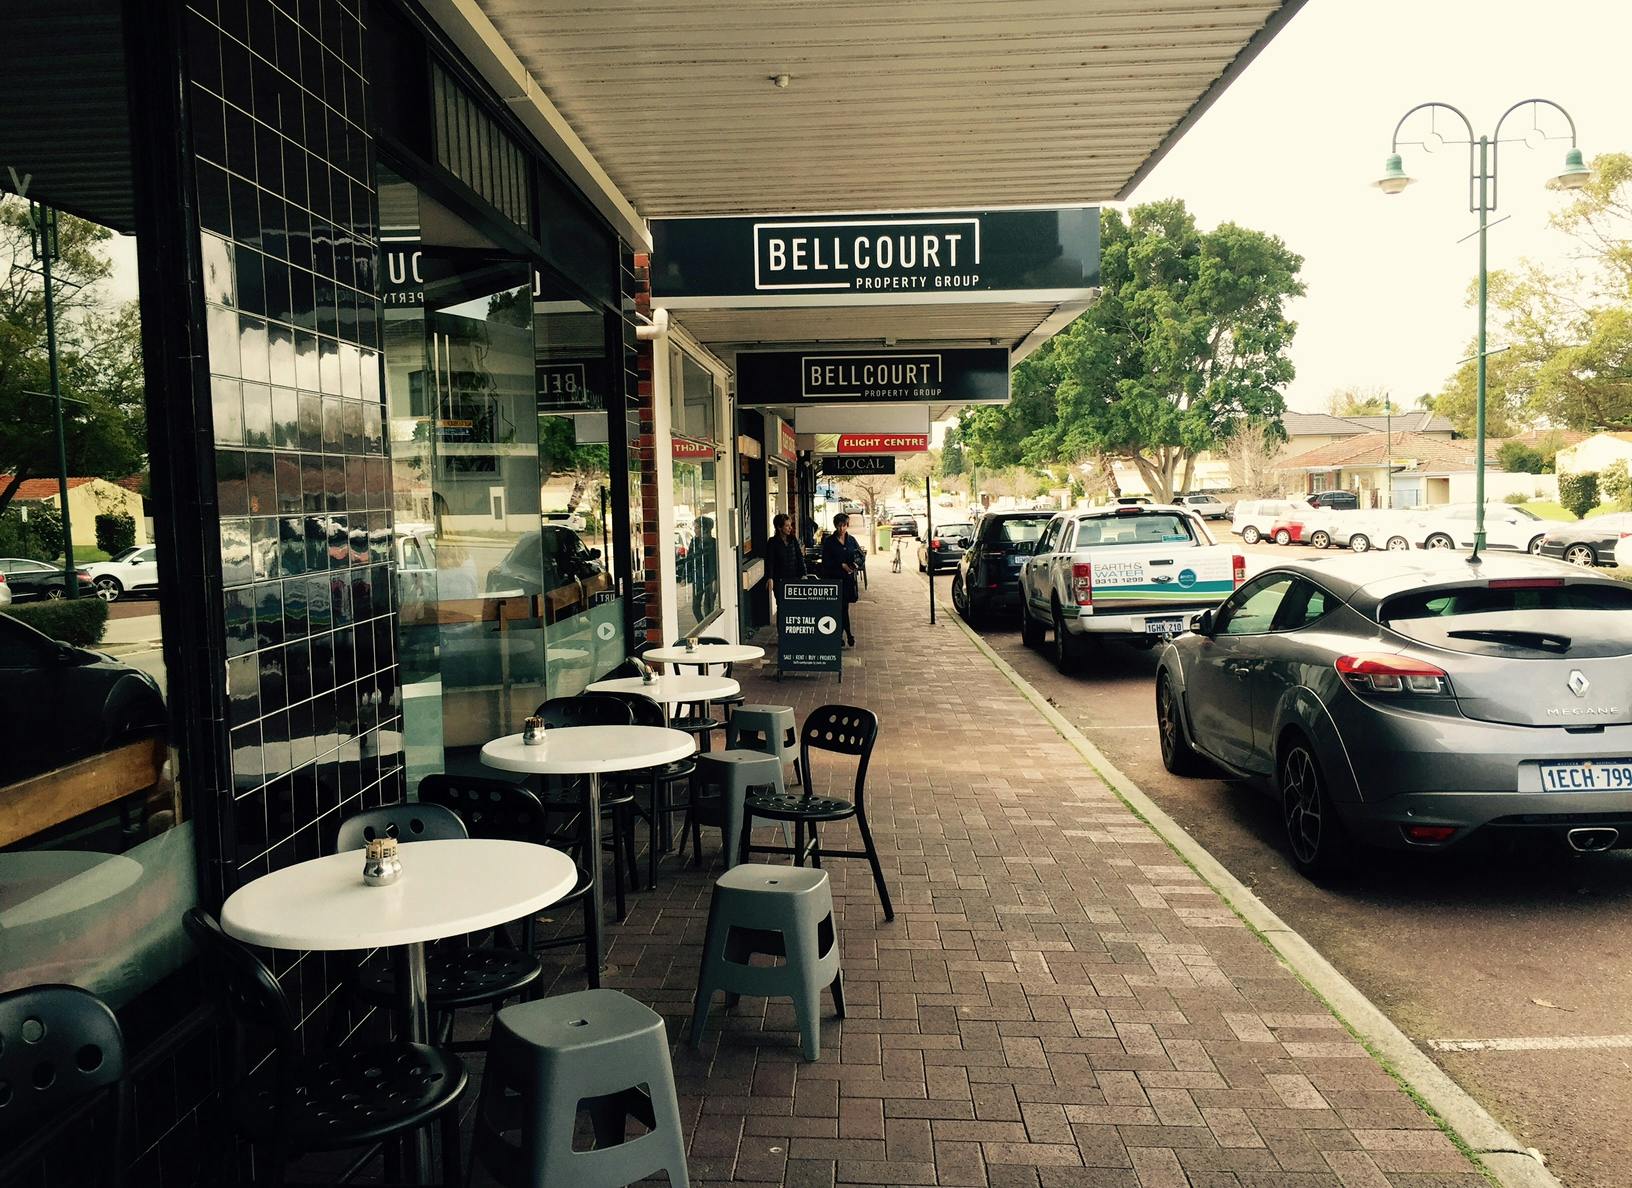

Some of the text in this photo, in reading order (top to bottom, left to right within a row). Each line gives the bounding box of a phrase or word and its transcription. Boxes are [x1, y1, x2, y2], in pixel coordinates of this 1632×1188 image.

[768, 233, 962, 272] BELLCOURT
[855, 274, 980, 289] PROPERTY GROUP
[810, 363, 931, 387] BELLCOURT
[864, 388, 942, 398] PROPERTY GROUP
[843, 437, 925, 447] FLIGHT CENTRE
[837, 458, 885, 470] LOCAL
[1094, 563, 1132, 571] EARTH
[1095, 570, 1144, 578] WATER
[787, 587, 834, 596] BELLCOURT
[785, 626, 815, 634] PROPERTY!
[1547, 706, 1621, 715] MEGANE
